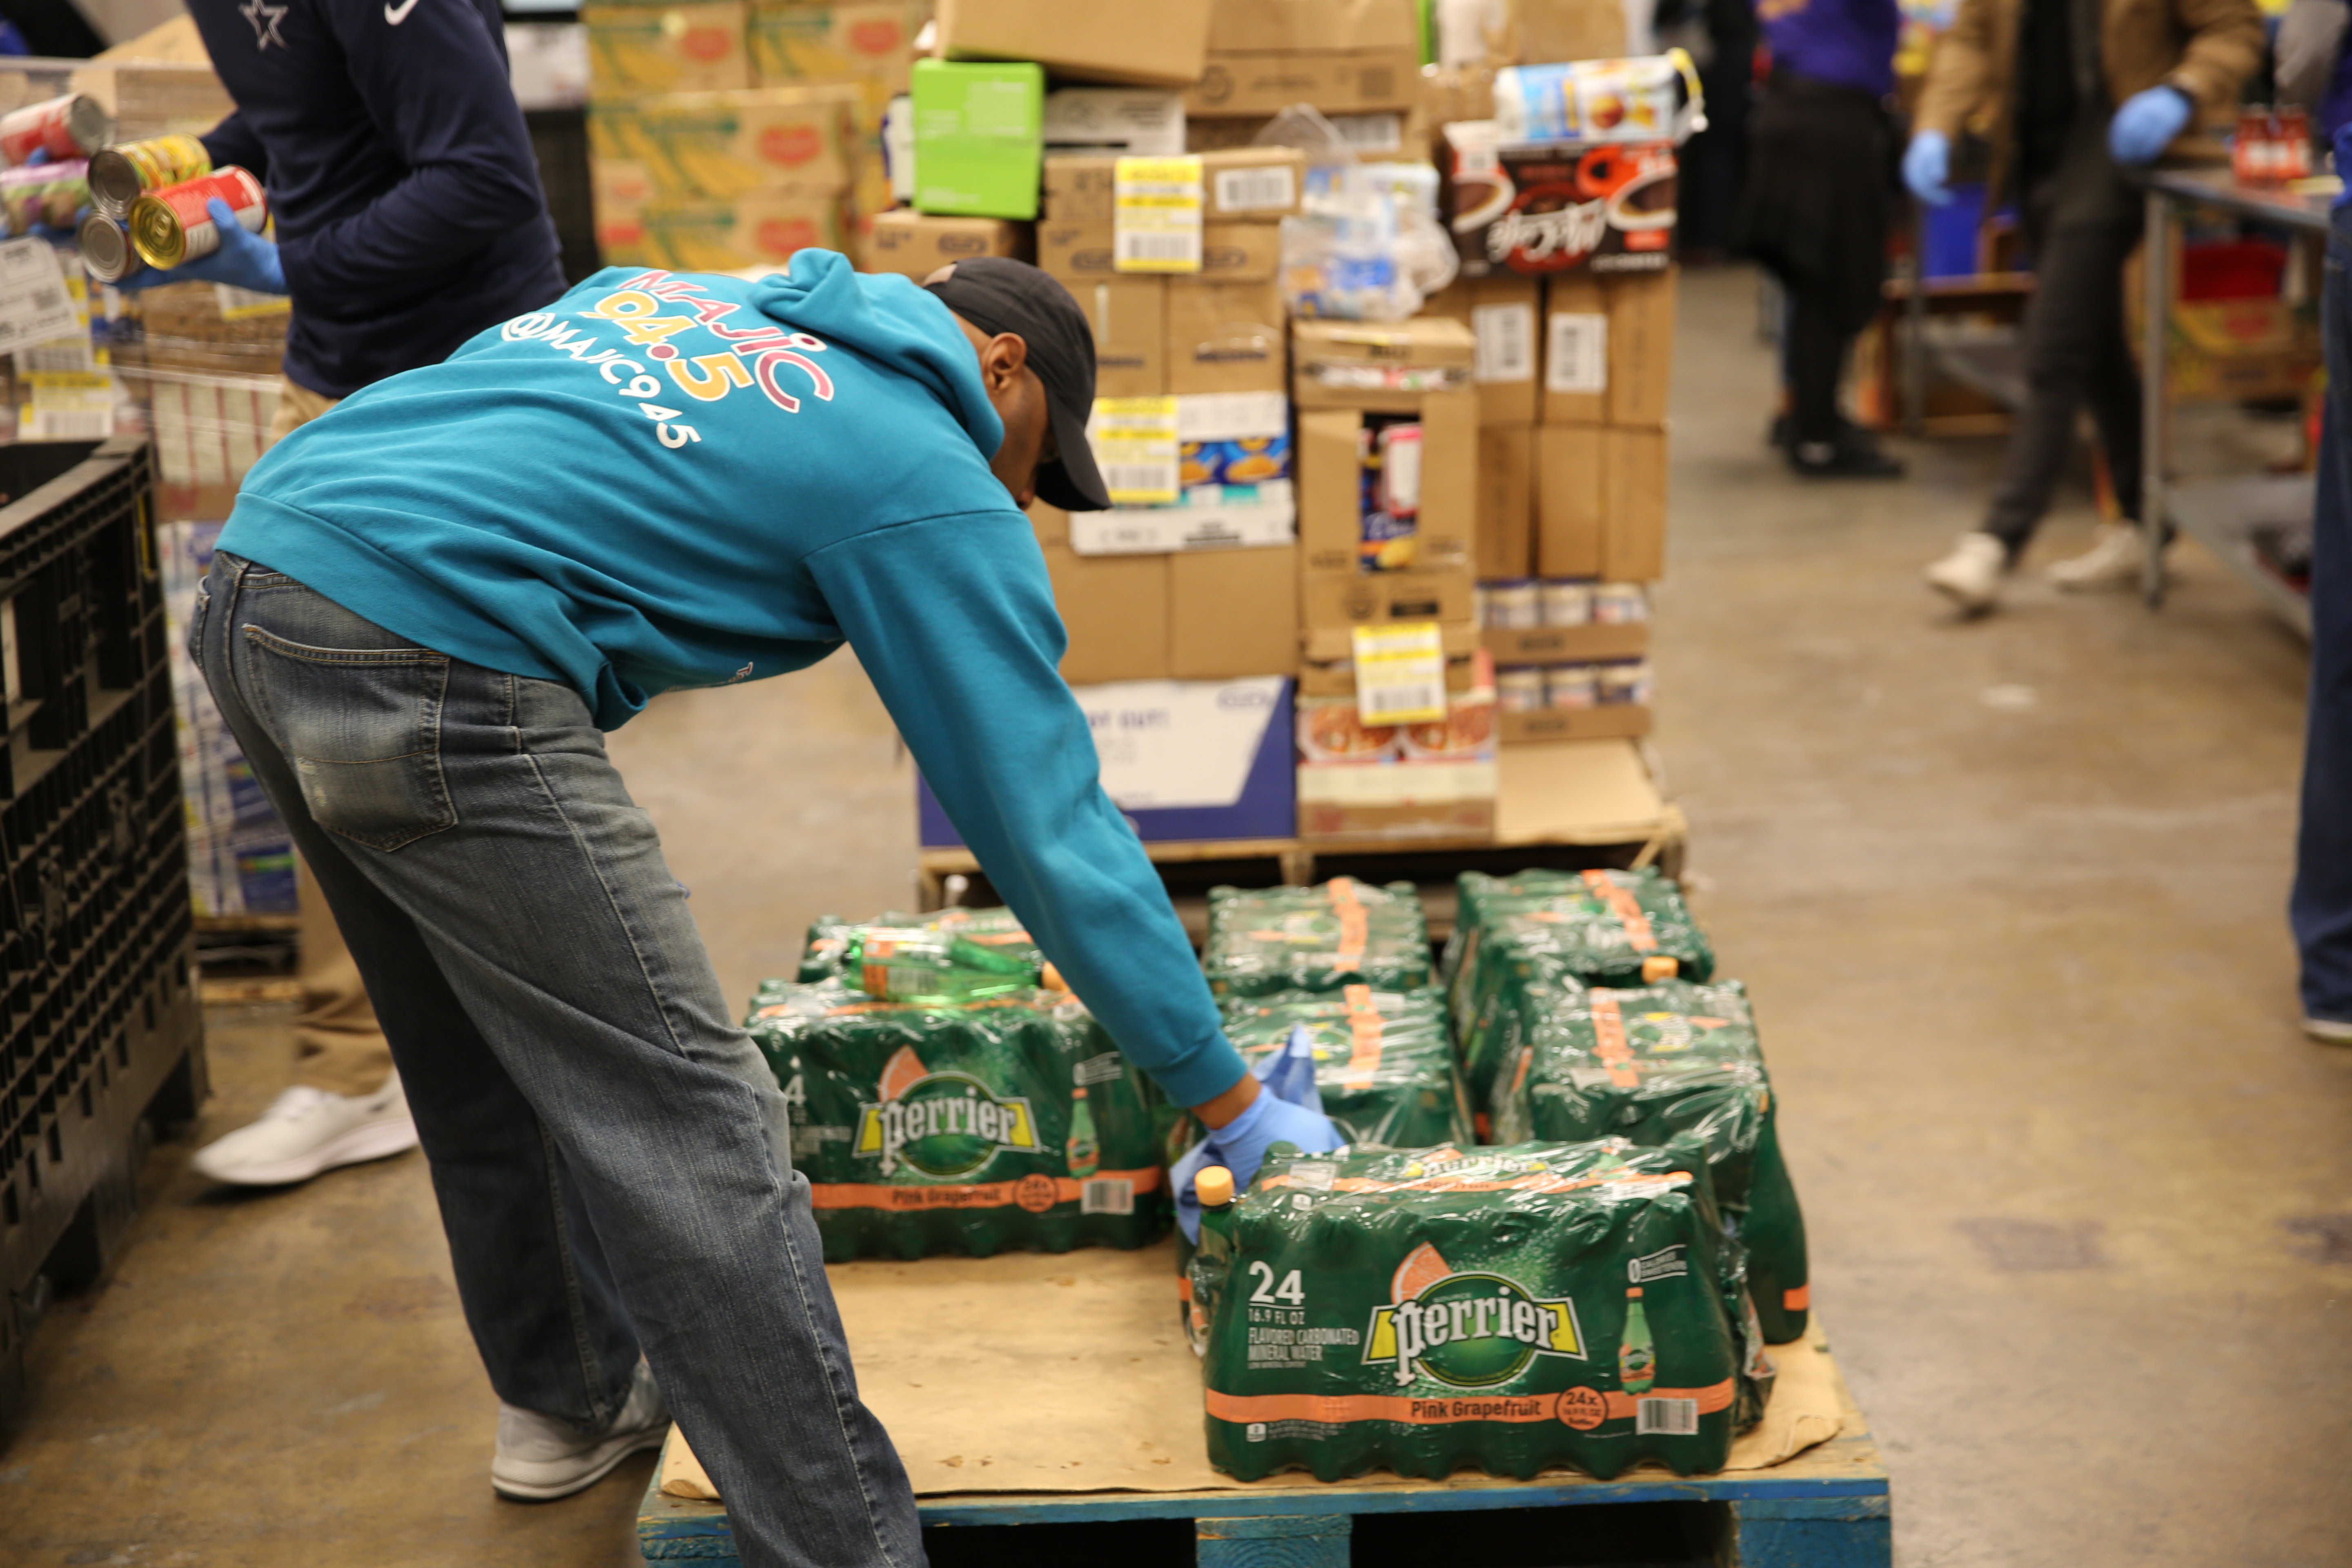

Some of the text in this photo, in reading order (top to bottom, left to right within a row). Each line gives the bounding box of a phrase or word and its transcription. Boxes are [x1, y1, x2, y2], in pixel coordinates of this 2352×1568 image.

[501, 312, 702, 448] @MAJIC945
[577, 290, 755, 401] 94.5
[618, 270, 834, 414] MAJIC
[878, 1085, 1017, 1177] perrier
[1248, 1308, 1305, 1325] 16.9 FL OZ
[1249, 1260, 1305, 1305] 24
[1390, 1285, 1558, 1386] perrier
[1411, 1401, 1448, 1418] Pink
[1452, 1399, 1541, 1419] Grapefruit
